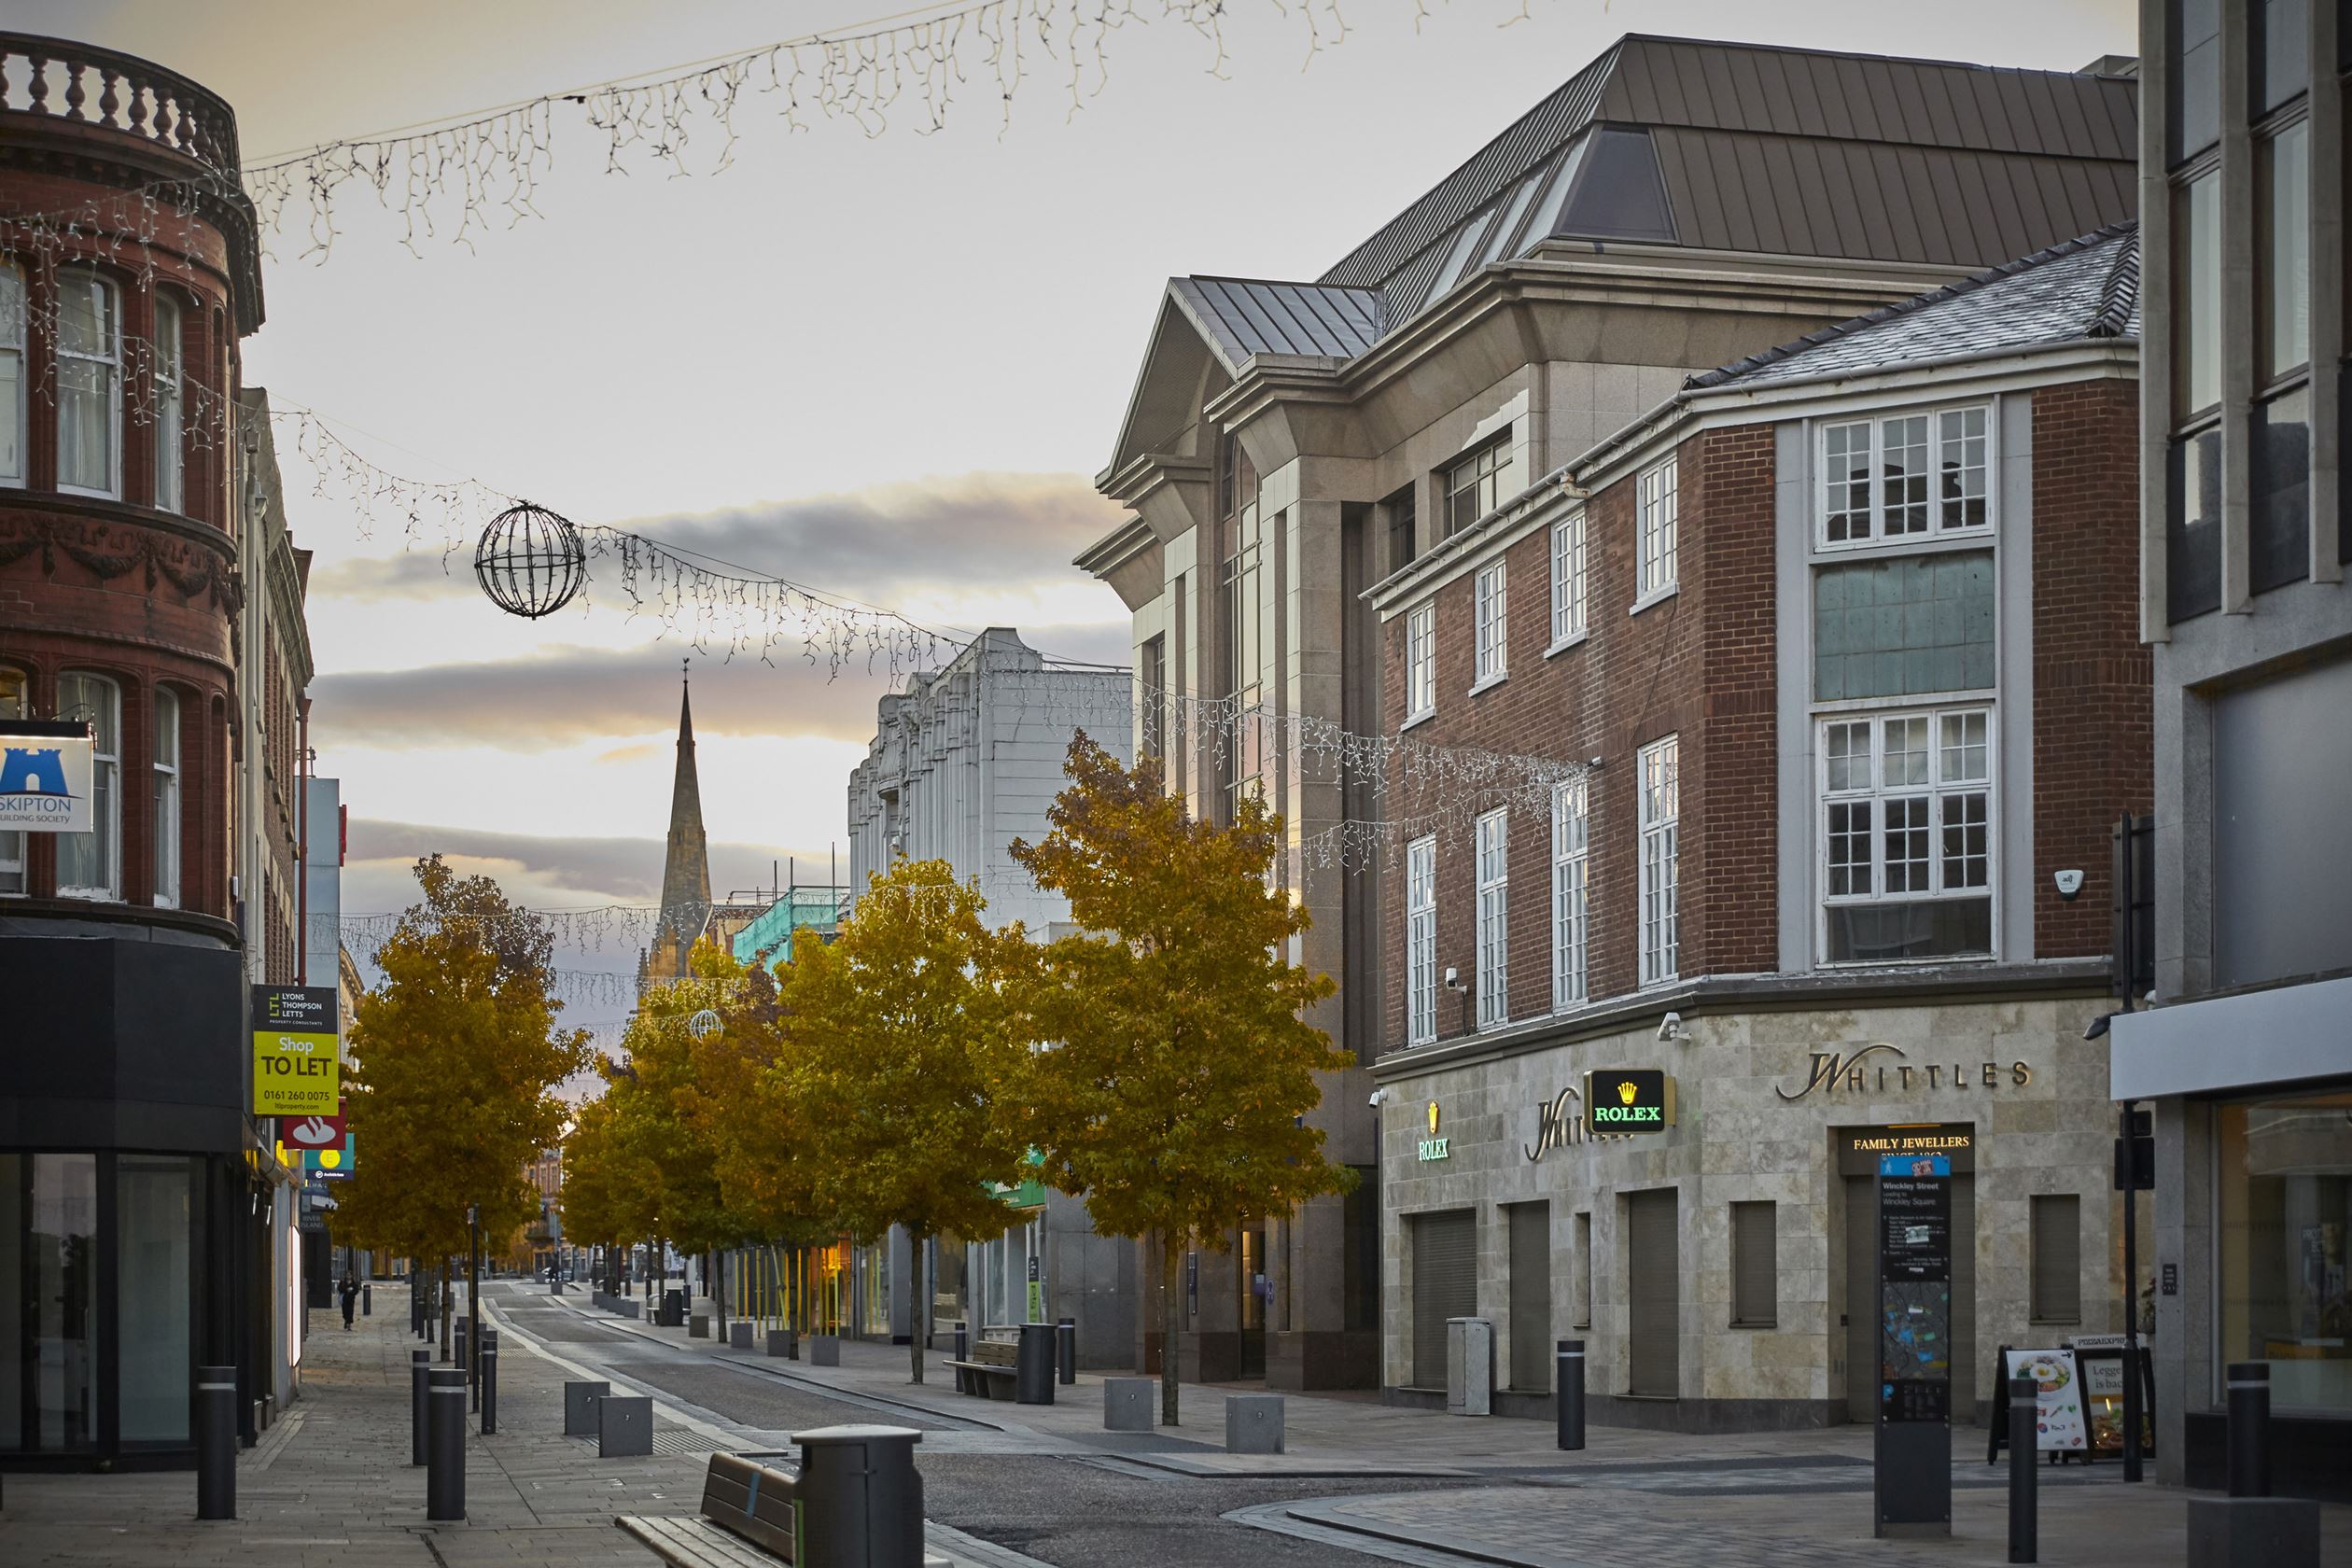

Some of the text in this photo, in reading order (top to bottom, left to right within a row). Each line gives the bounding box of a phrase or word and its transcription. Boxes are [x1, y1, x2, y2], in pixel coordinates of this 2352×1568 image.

[0, 797, 71, 812] SKIPTON
[0, 814, 70, 824] UILDING SOCIETY
[282, 992, 305, 1001] LYONS
[269, 993, 280, 1017] LTL
[282, 1001, 322, 1010] THOMPSON
[282, 1010, 304, 1018] LETTS
[279, 1037, 315, 1056] Shop
[261, 1056, 332, 1076] TO LET
[264, 1089, 329, 1101] 0161 260 0075
[1594, 1106, 1661, 1123] ROLEX
[1854, 1136, 1969, 1150] FAMILY JEWELLERS
[1418, 1138, 1449, 1162] ROLEX
[1883, 1182, 1939, 1191] Winckley Street
[1883, 1197, 1937, 1207] Winckley Square
[2095, 1378, 2122, 1389] is bac
